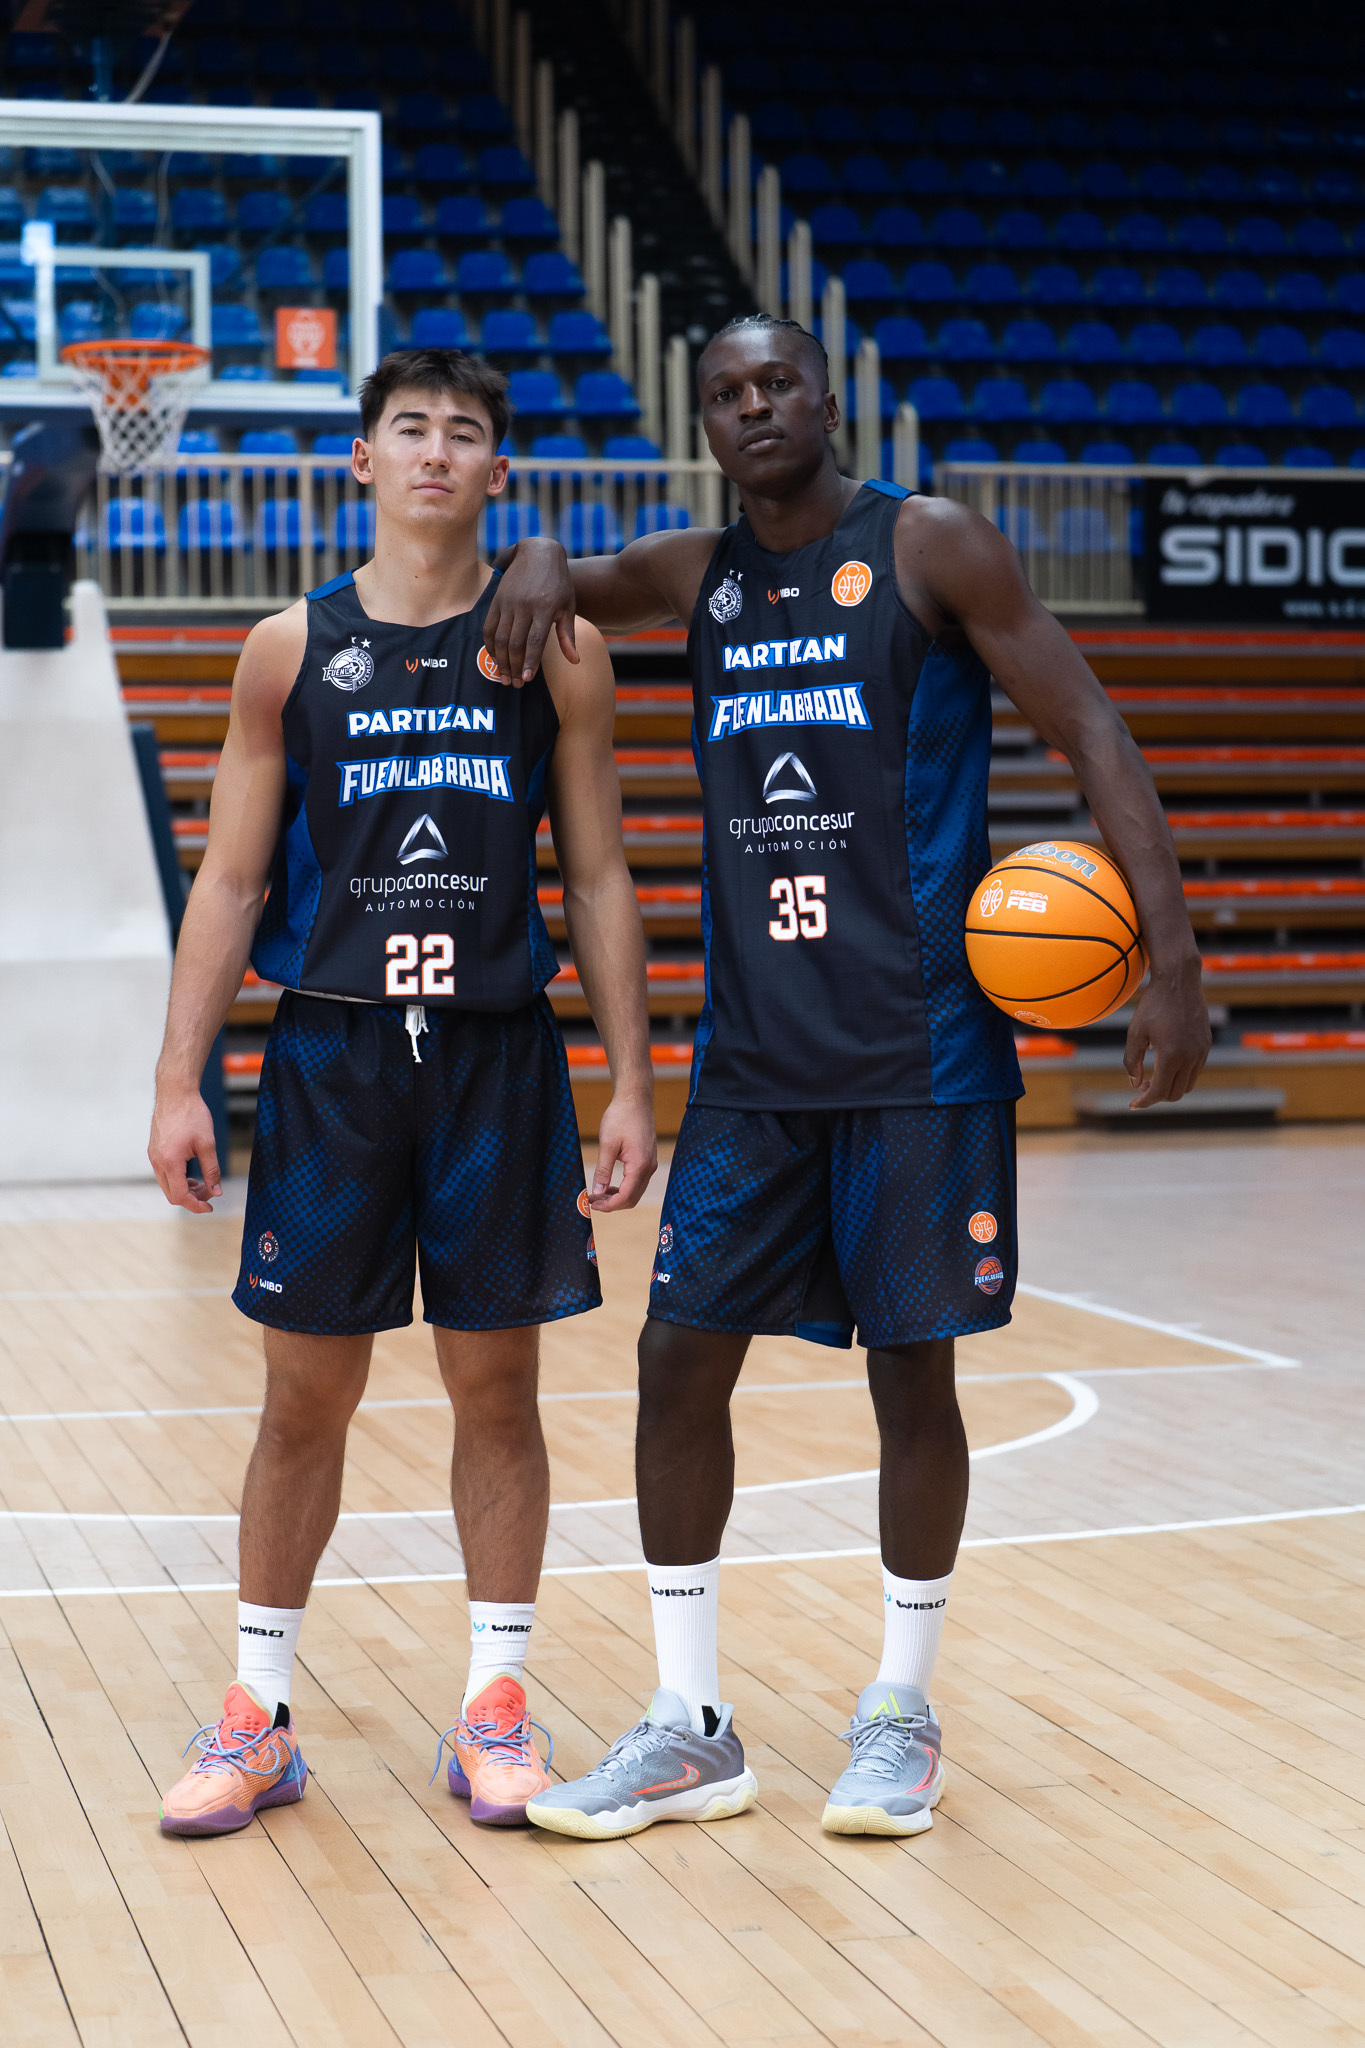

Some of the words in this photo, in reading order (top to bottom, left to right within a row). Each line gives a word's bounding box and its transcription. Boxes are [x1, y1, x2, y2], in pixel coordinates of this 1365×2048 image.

[347, 705, 495, 737] PARTIZAN
[339, 755, 512, 804] FUENLABRADA
[729, 811, 855, 839] grupoconcesur
[745, 838, 847, 854] AUTOMOCIÓN
[1006, 843, 1098, 879] ilson
[350, 873, 488, 898] grupoconcesur
[1009, 889, 1049, 901] PRIMERA
[365, 898, 475, 912] AUTOMOCIÓN
[768, 875, 828, 941] 35
[1006, 896, 1048, 913] FEB
[385, 933, 455, 996] 22
[259, 1278, 283, 1293] WIBO
[651, 1586, 704, 1597] WIBO
[896, 1597, 946, 1610] WIBO
[239, 1624, 285, 1638] WIBO
